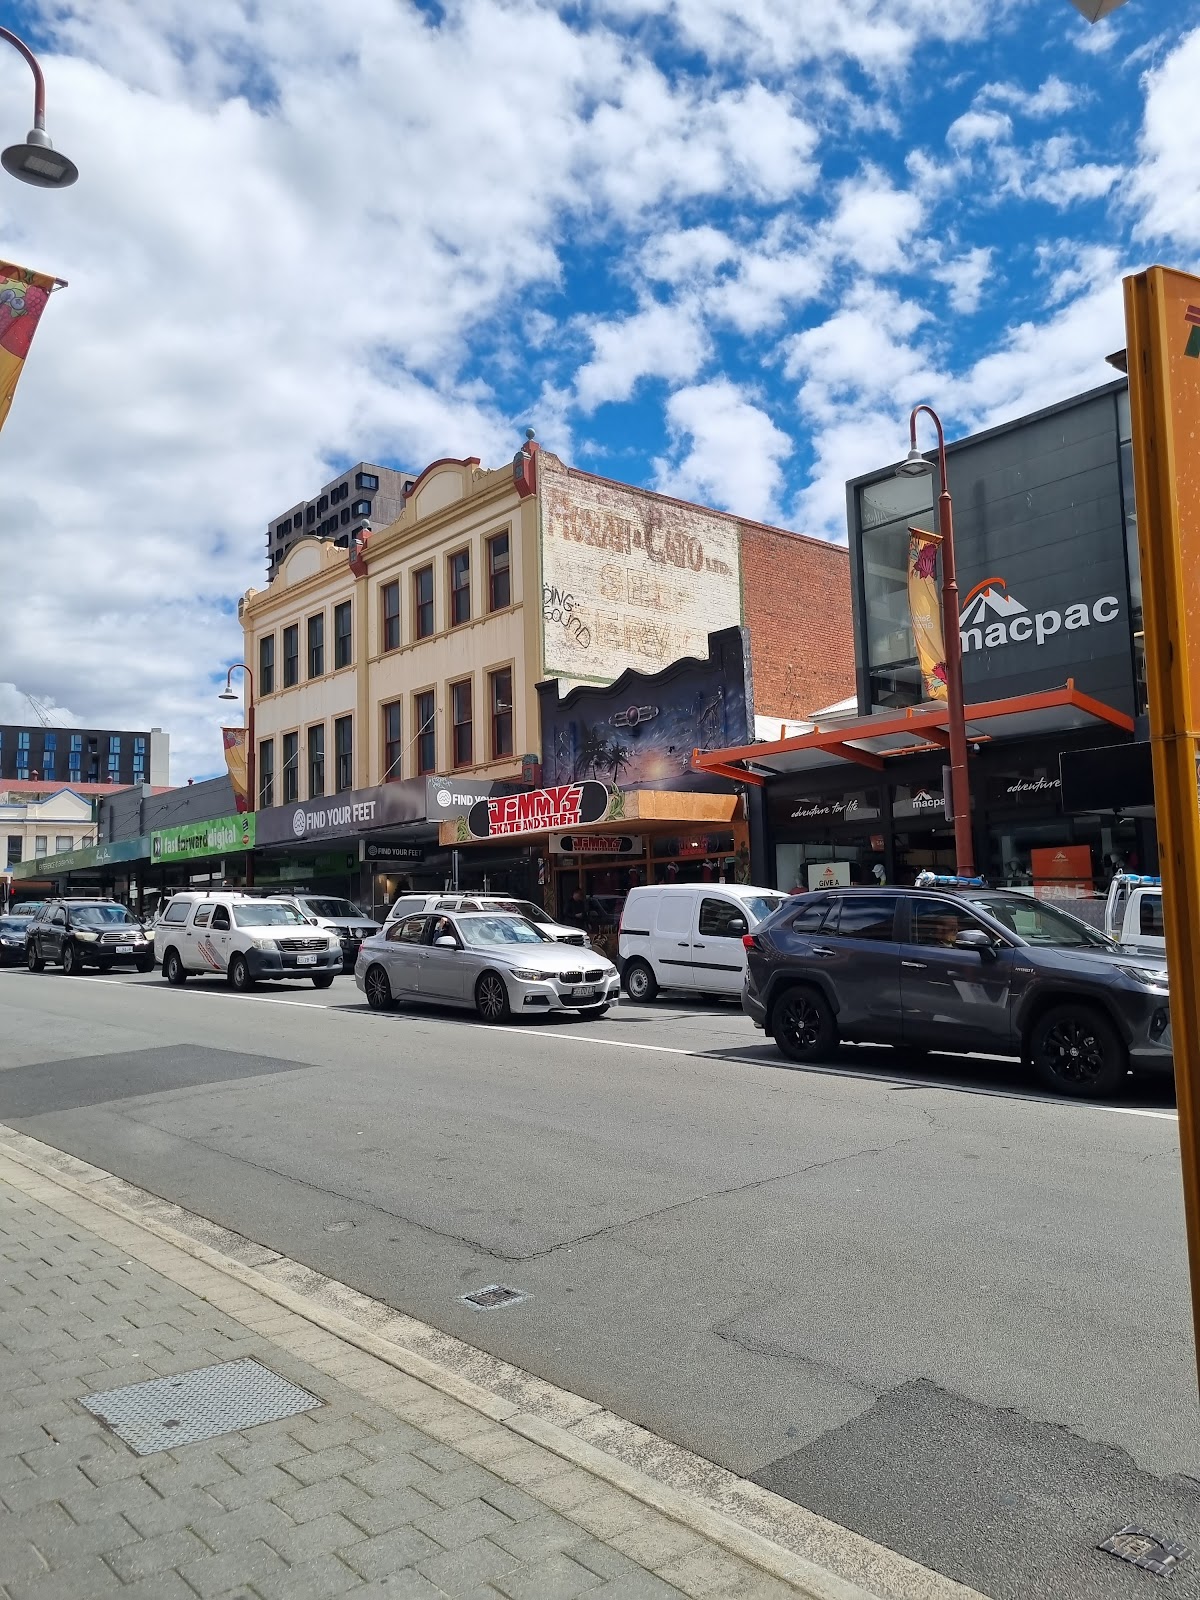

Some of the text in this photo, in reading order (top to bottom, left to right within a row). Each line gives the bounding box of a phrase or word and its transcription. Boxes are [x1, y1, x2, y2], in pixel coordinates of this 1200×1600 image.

[959, 595, 1119, 653] macpac
[1006, 777, 1062, 792] adventure
[452, 793, 473, 806] FIND
[912, 799, 946, 809] macpa
[306, 800, 376, 830] FIND YOUR FEET
[791, 799, 859, 818] adventure for life
[489, 811, 580, 835] SKATE AND STREET
[377, 847, 422, 857] FIND YOUR FEET
[818, 879, 833, 887] GIVE
[1040, 883, 1086, 899] SALE
